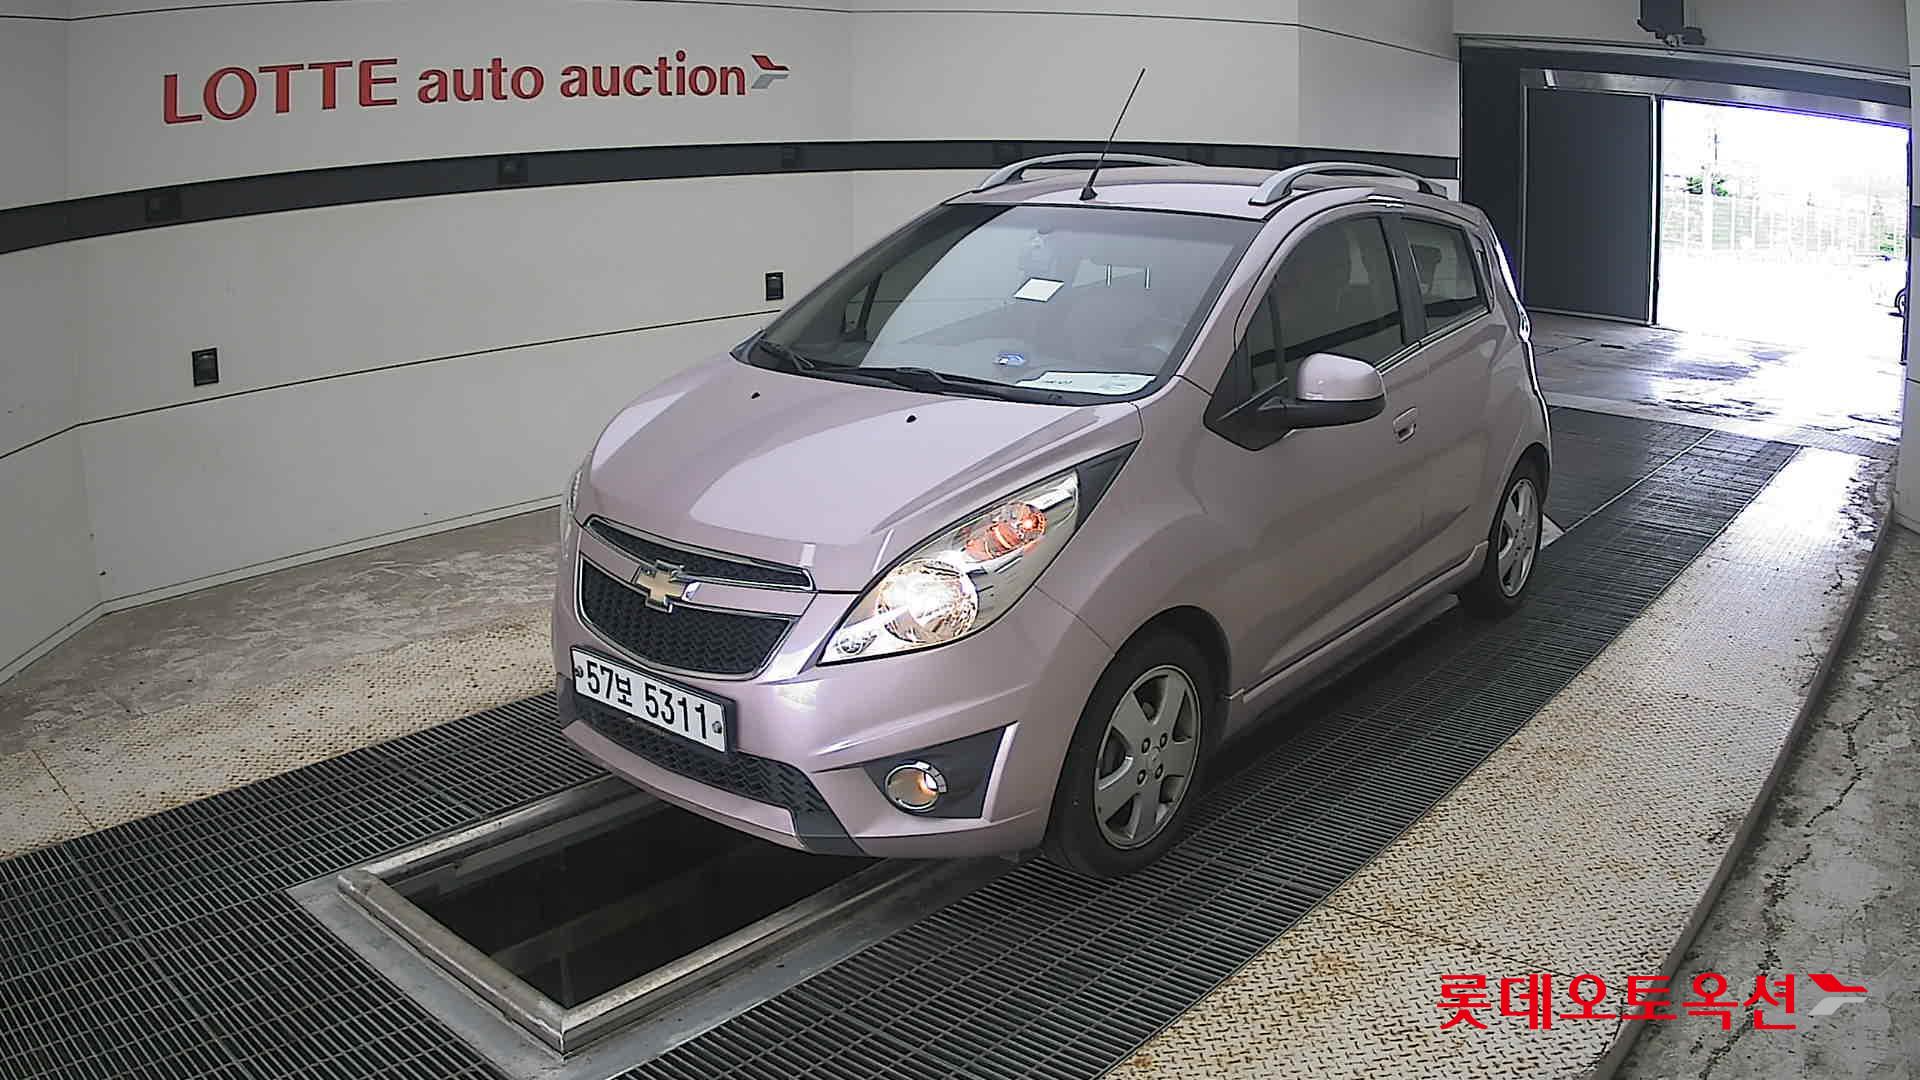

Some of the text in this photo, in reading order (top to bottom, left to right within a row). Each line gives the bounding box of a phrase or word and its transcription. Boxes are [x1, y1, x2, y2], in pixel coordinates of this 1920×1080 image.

[164, 49, 746, 124] LOTTE auto auction
[586, 660, 707, 740] 57보 5311
